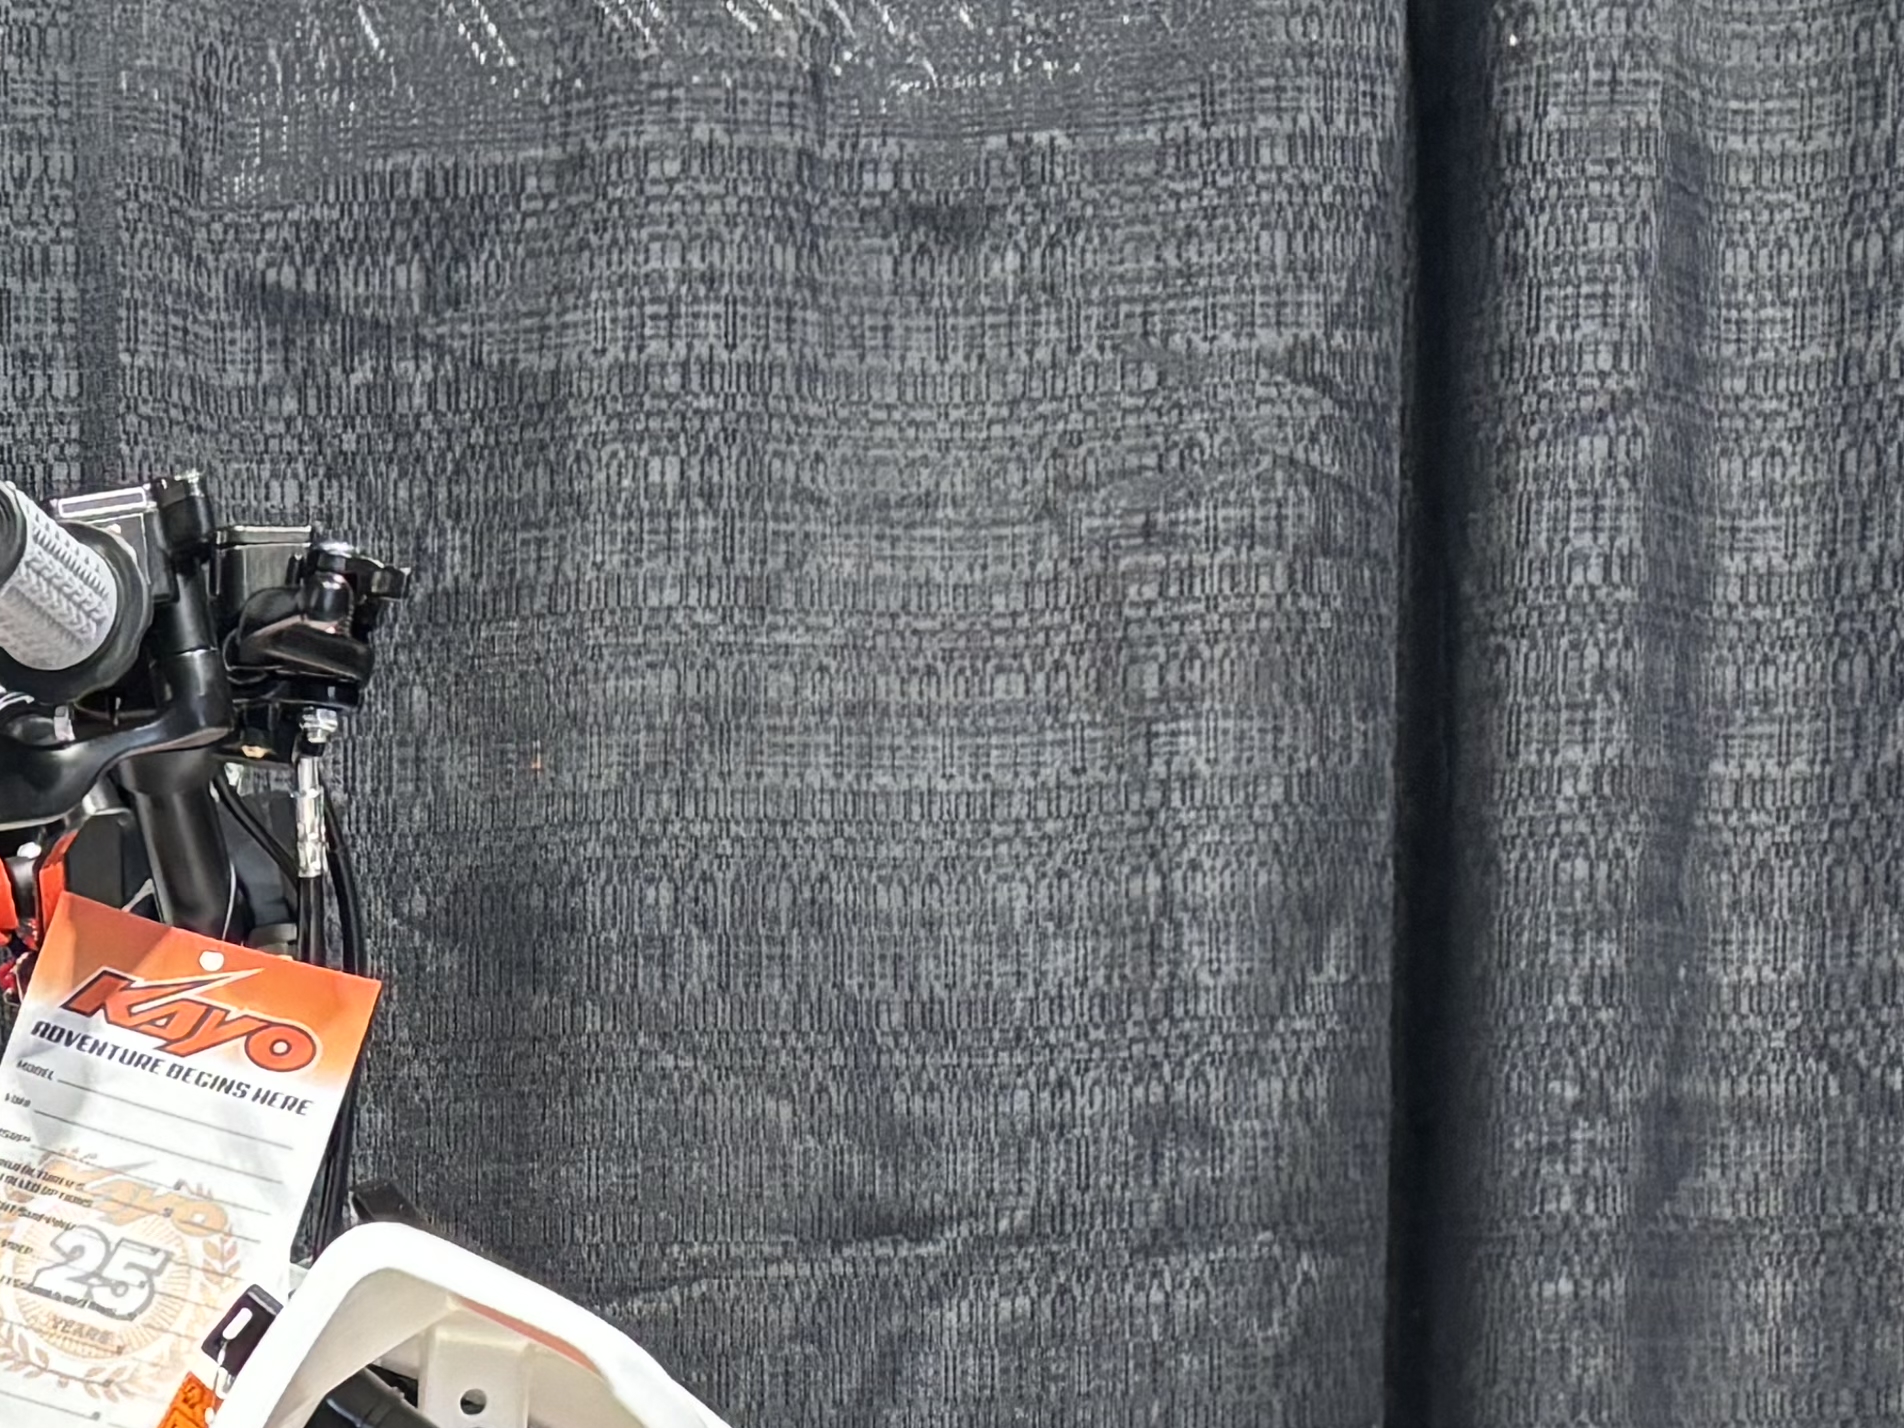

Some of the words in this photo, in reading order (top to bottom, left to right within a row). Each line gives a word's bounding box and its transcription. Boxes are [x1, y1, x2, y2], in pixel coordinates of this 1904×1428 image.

[60, 966, 320, 1072] KAYO
[16, 1059, 55, 1081] MODEL
[31, 1020, 167, 1074] ADVENTURE
[165, 1059, 255, 1099] BEGINS
[251, 1087, 314, 1117] HERE
[32, 1224, 175, 1322] 25
